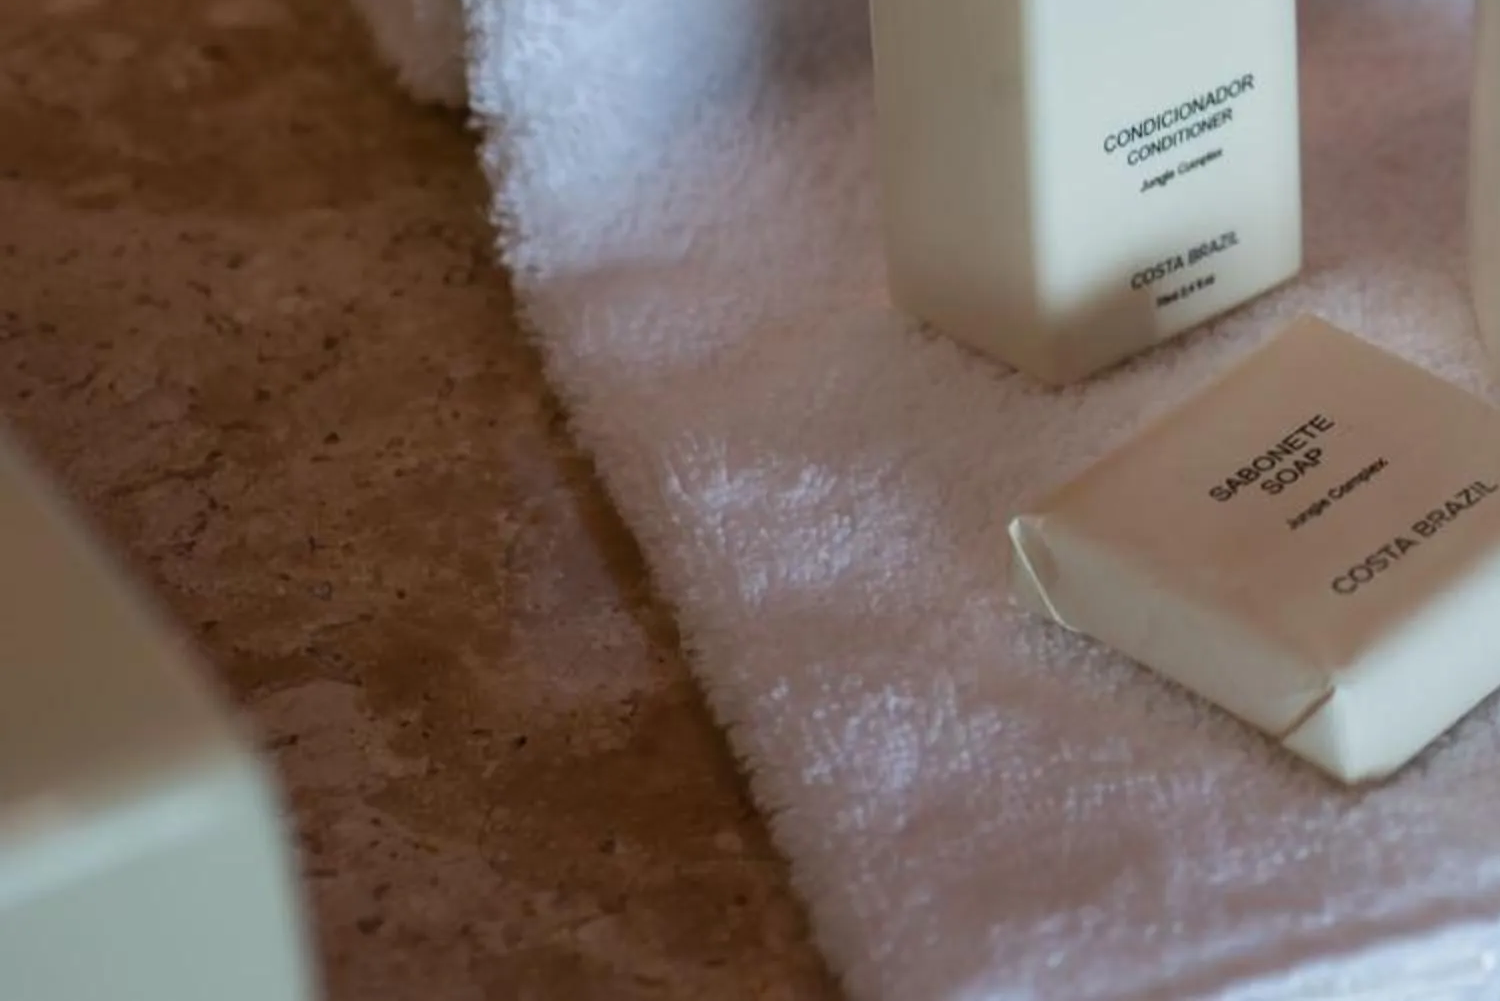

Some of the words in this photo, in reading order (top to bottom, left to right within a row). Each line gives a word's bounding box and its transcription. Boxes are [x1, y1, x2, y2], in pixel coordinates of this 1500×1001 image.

[1103, 73, 1255, 153] CONDICIONADOR
[1127, 107, 1233, 166] CONDITIONER
[1140, 169, 1175, 193] Jungle
[1177, 148, 1223, 175] Complex
[1130, 255, 1184, 290] COSTA
[1188, 231, 1239, 265] BRAZIL
[1208, 414, 1335, 502] SABONETE
[1260, 447, 1323, 496] SOAP
[1286, 499, 1331, 530] Jungle
[1328, 457, 1389, 499] Complex
[1331, 535, 1421, 596] COSTA
[1411, 479, 1499, 538] BRAZIL
